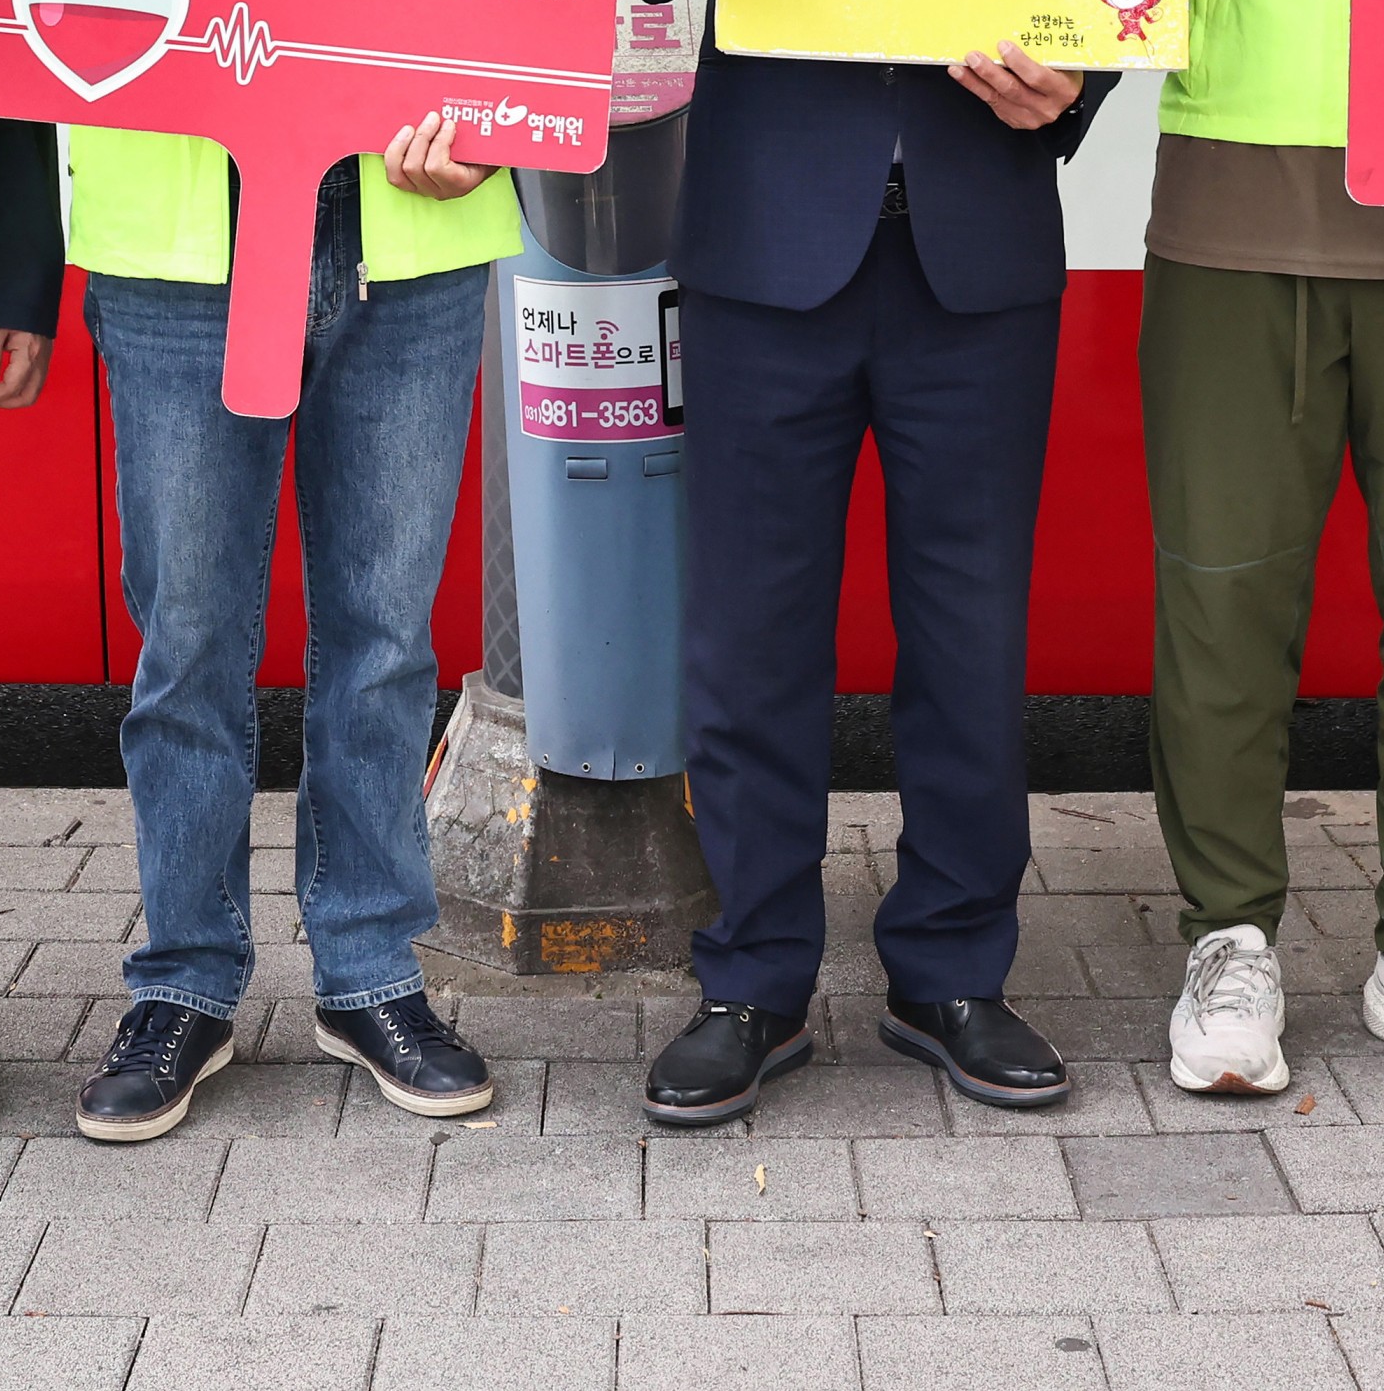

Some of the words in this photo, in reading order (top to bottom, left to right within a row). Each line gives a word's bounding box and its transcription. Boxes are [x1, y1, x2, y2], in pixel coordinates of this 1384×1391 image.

[1030, 14, 1075, 30] 헌혈하는
[1020, 32, 1053, 47] 당신이
[1059, 33, 1084, 48] 영웅!
[527, 113, 584, 146] 혈액원
[522, 307, 577, 335] 언제나
[524, 339, 656, 370] 스마트폰으로
